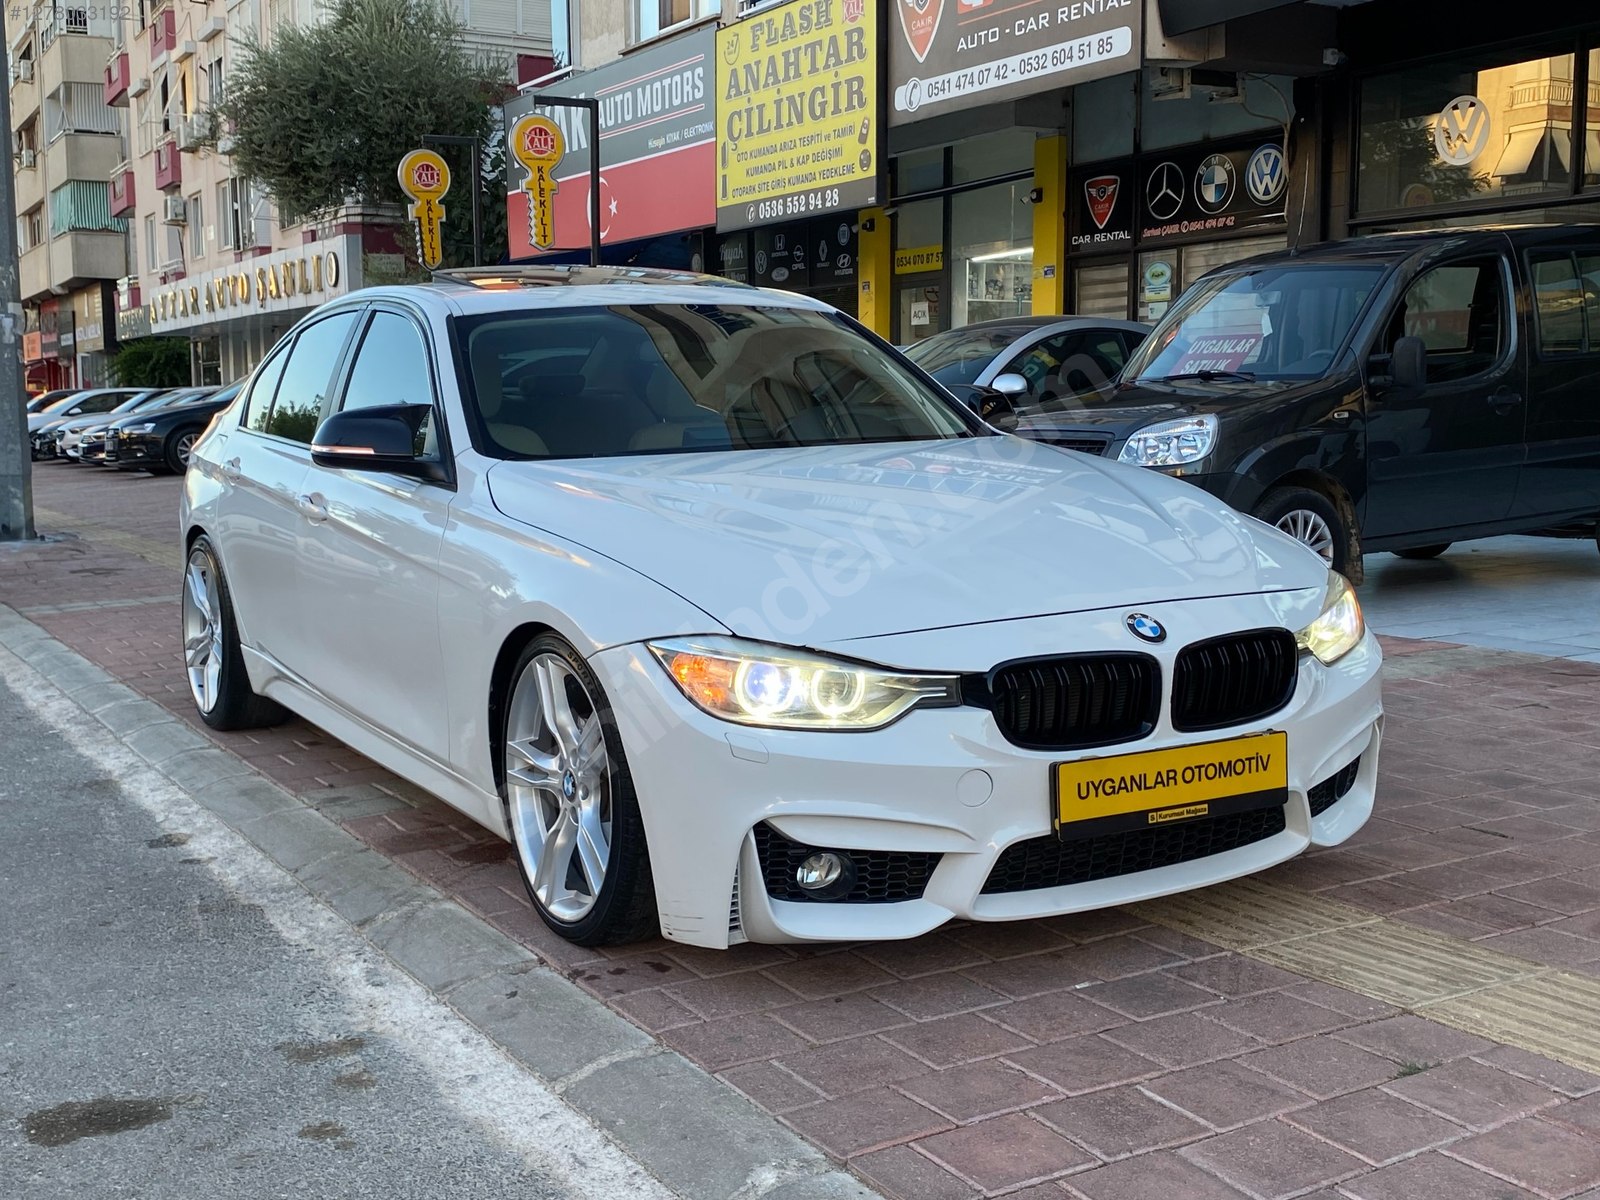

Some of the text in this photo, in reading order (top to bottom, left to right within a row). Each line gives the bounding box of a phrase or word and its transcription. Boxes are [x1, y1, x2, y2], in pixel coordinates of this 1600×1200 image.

[750, 0, 833, 52] FLASH
[957, 27, 999, 52] AUTO
[1015, 13, 1050, 36] CAR
[726, 26, 867, 100] ANAHTAR
[927, 73, 952, 98] 0541
[955, 72, 975, 91] 474
[977, 68, 992, 85] 07
[994, 64, 1008, 81] 42
[1019, 53, 1047, 75] 0532
[1051, 46, 1073, 67] 604
[1078, 41, 1092, 61] 51
[1097, 36, 1113, 55] 85
[599, 67, 704, 129] AUTO MOTORS
[726, 71, 867, 152] ÇİLİNGİR
[524, 133, 555, 153] KALE
[737, 151, 748, 162] OTO
[749, 144, 778, 159] KUMANDA
[779, 139, 797, 152] ARIZA
[824, 133, 831, 141] ve
[413, 171, 441, 185] KALE
[732, 184, 756, 198] OTOPARK
[788, 172, 817, 187] KUMANDA
[819, 163, 855, 180] YEDEKLEME
[746, 162, 776, 177] KUMANDA
[790, 158, 795, 168] &
[796, 154, 810, 166] KAP
[759, 188, 839, 219] 0536 552 94 28
[1072, 230, 1131, 245] CAR RENTAL
[896, 255, 911, 267] 0534
[912, 254, 925, 265] 070
[1187, 338, 1256, 355] UYGANLAR
[1077, 752, 1271, 801] UYGANLAR OTOMOTİV
[1158, 809, 1185, 820] Kurumsal
